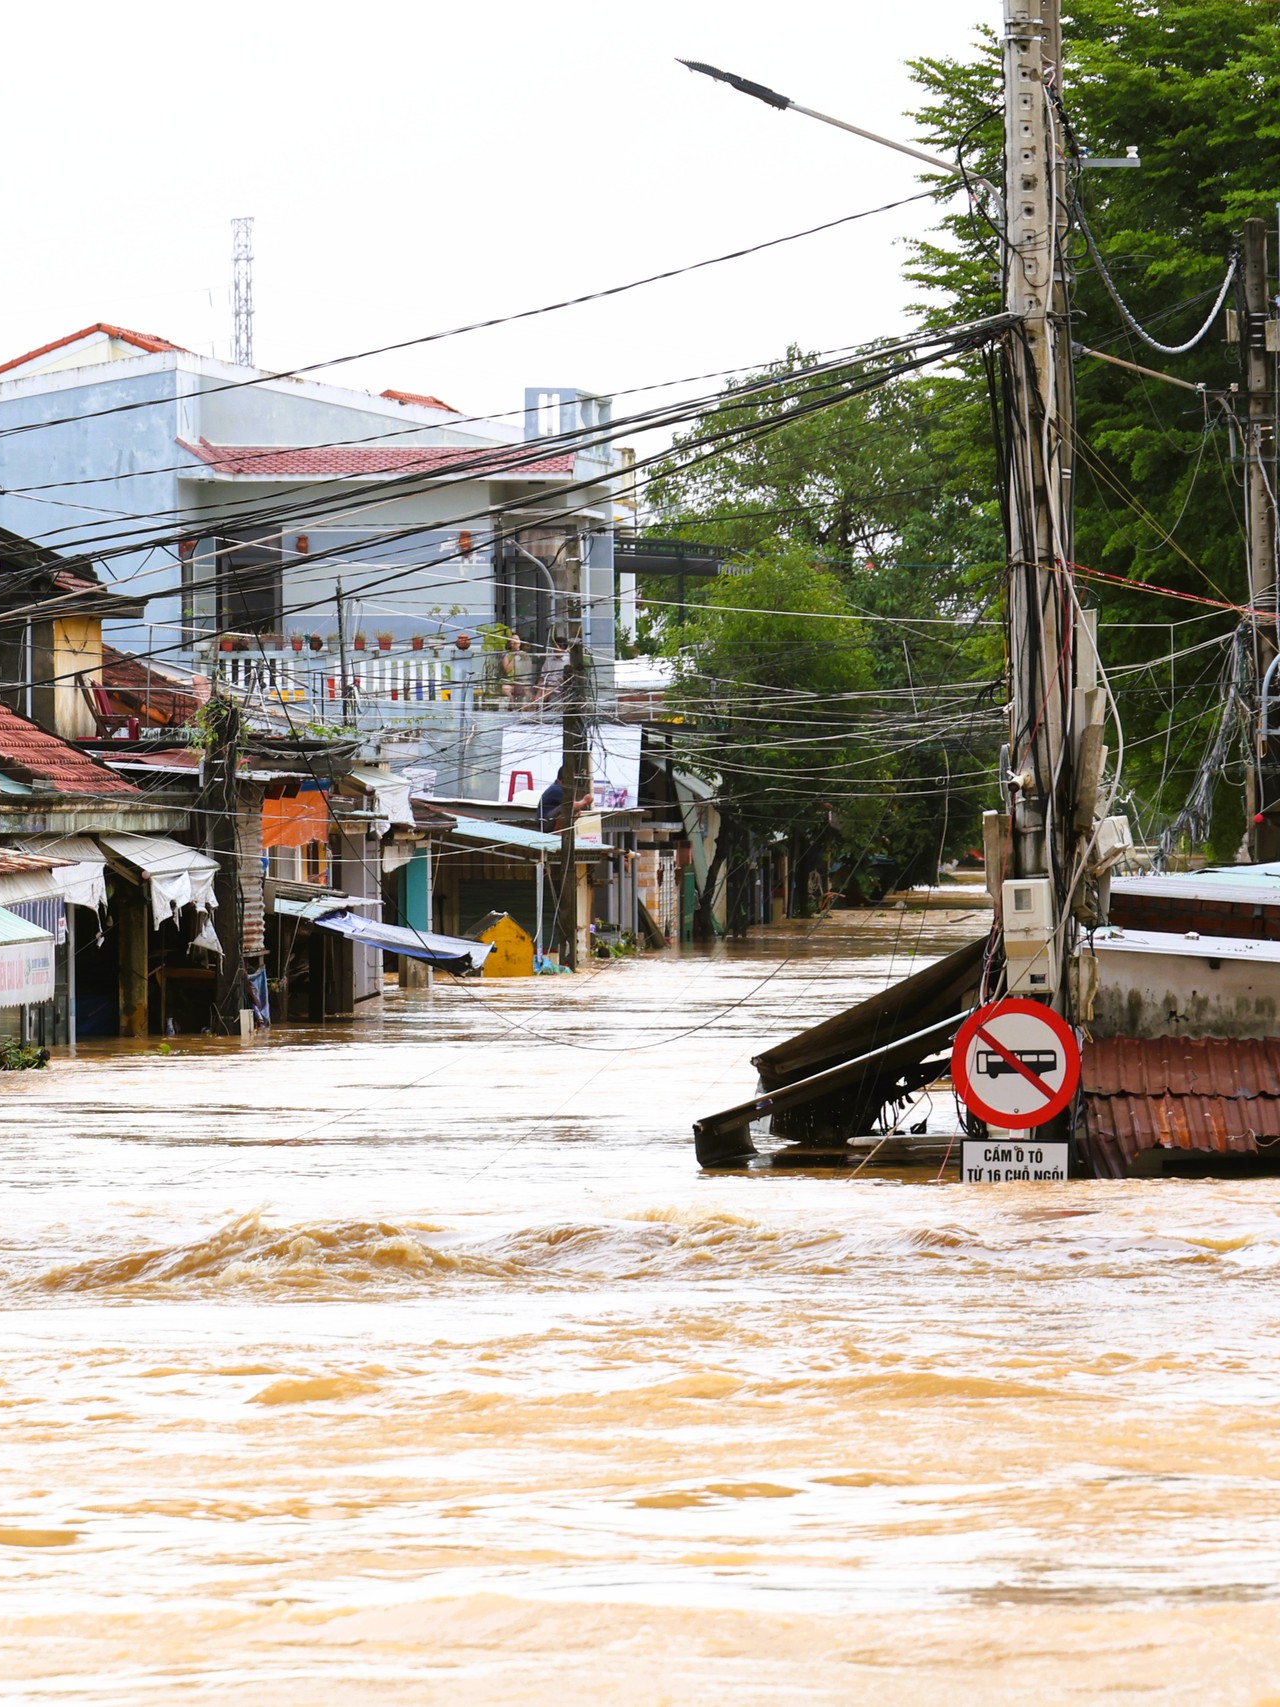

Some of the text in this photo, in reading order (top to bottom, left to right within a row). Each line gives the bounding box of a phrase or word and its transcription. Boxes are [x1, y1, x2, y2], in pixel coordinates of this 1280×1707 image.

[984, 1144, 1043, 1163] CẤM Ô TÔ
[967, 1165, 984, 1182] TỪ
[987, 1170, 1001, 1182] 16
[1005, 1165, 1030, 1181] CHỖ
